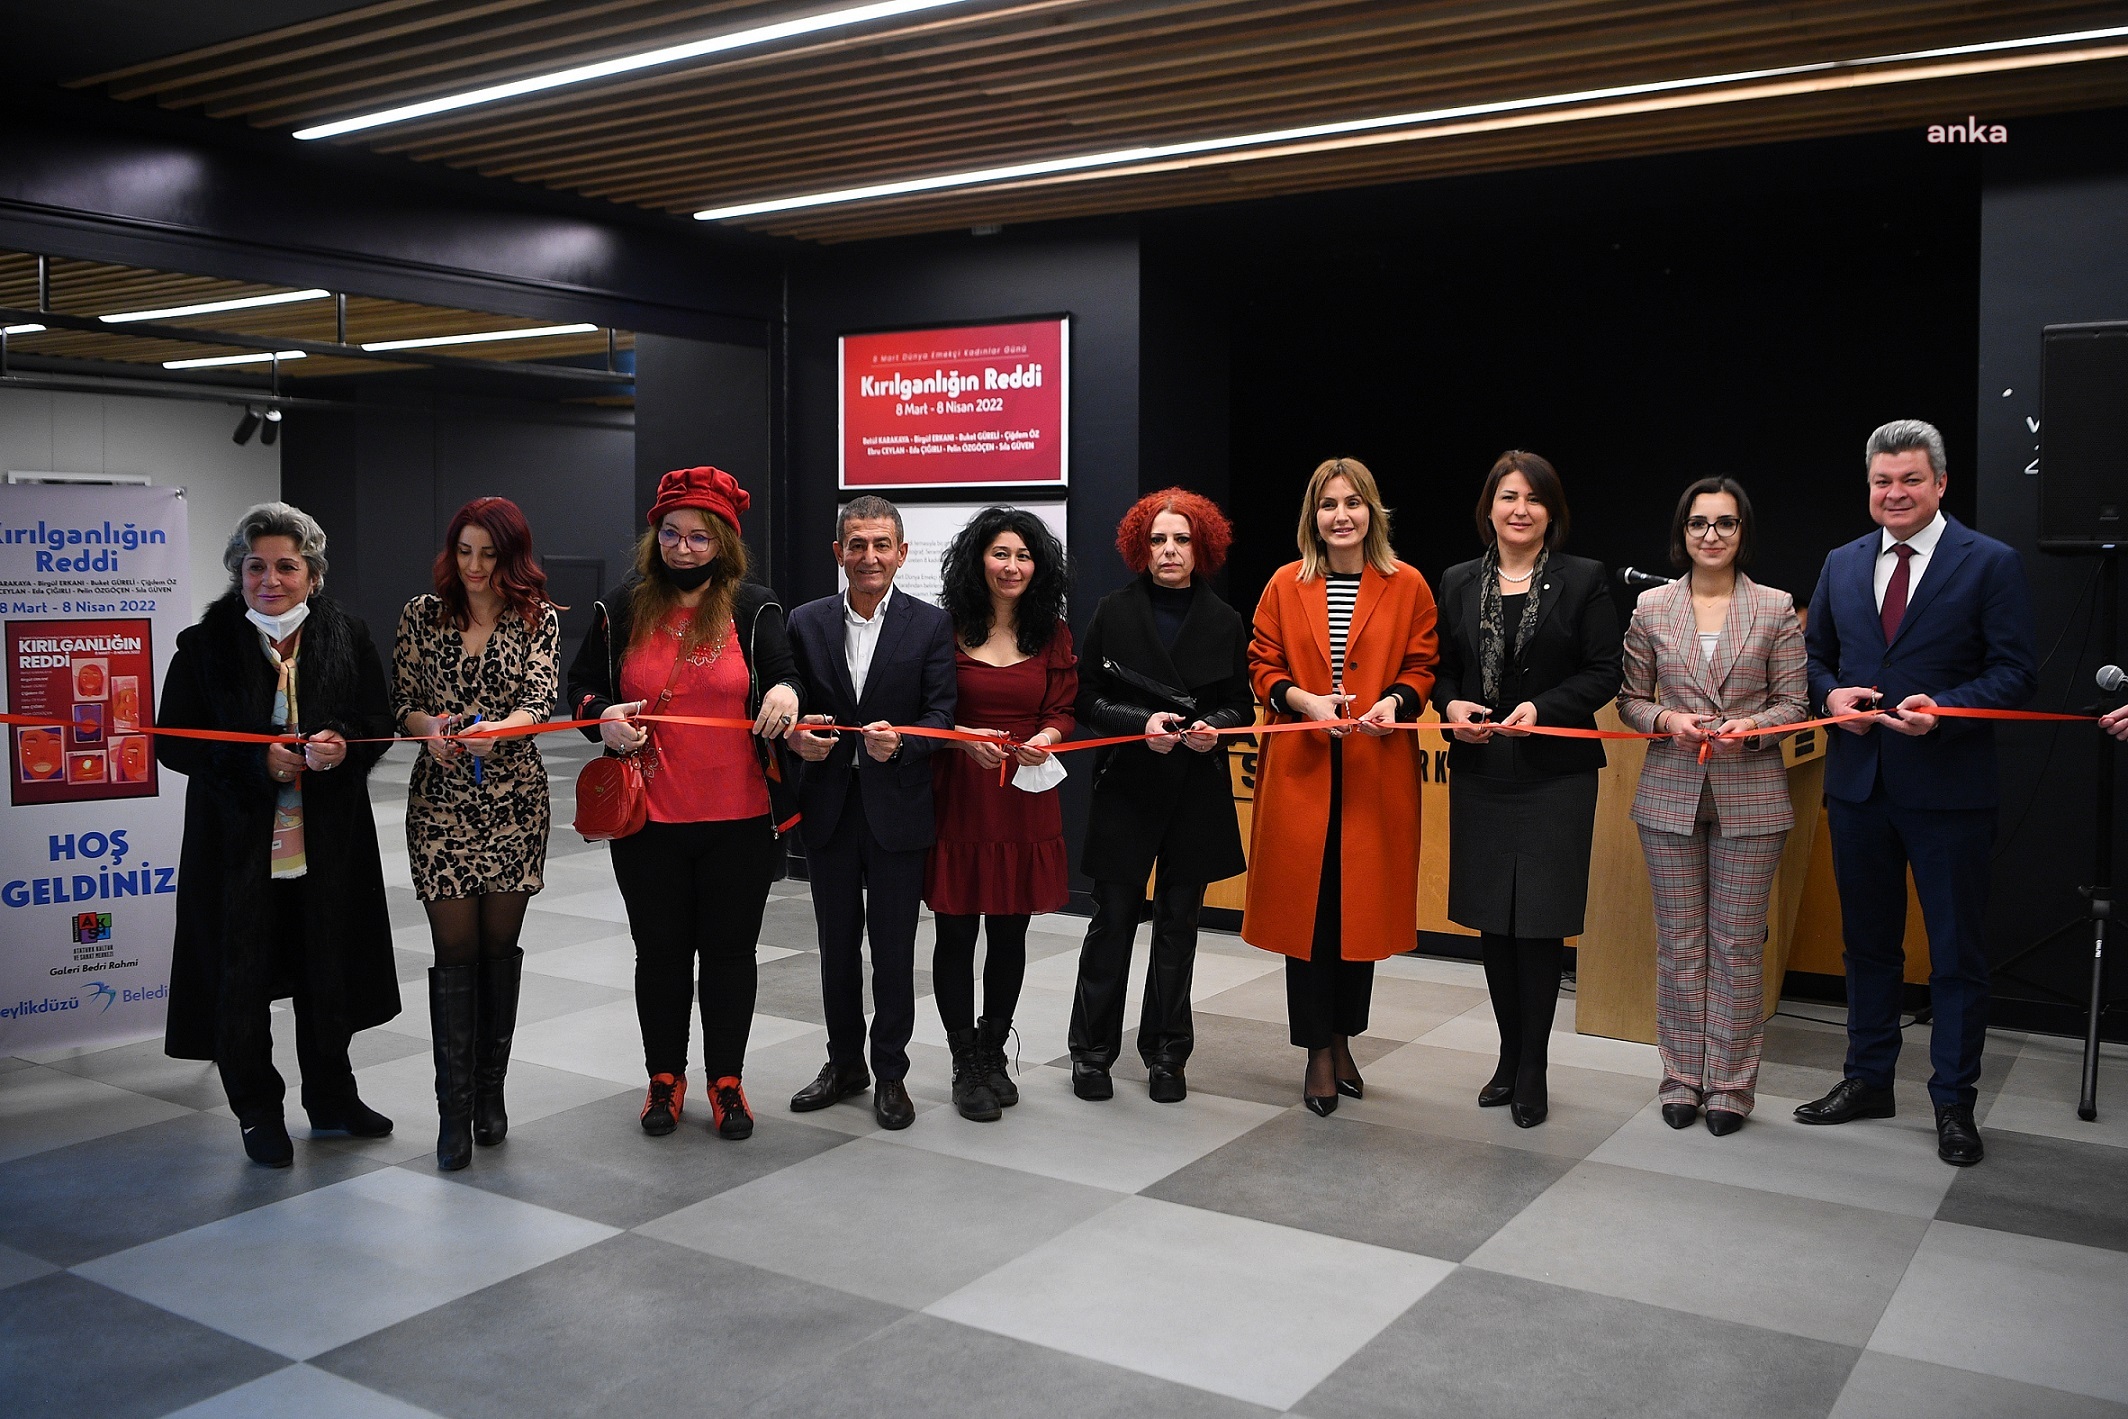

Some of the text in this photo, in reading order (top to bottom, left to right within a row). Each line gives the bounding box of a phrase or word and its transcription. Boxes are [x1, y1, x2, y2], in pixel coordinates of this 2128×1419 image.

[880, 354, 899, 362] Mart
[902, 352, 928, 362] Dünya
[931, 349, 960, 360] Emekçi
[964, 347, 1000, 357] Kadınlar
[1004, 344, 1027, 355] Günü
[861, 363, 1042, 400] Kırılganlığın Reddi
[896, 403, 903, 416] 8
[904, 402, 928, 416] Mart
[936, 401, 944, 414] 8
[946, 400, 974, 414] Nisan
[976, 398, 1003, 412] 2022
[1004, 430, 1028, 442] Çiğdem
[1029, 428, 1040, 438] ÖZ
[1011, 440, 1034, 450] GÜVEN
[0, 520, 166, 550] ırılganlığın
[36, 549, 118, 572] Reddi
[38, 580, 58, 588] Birgül
[94, 586, 130, 594] ÖZGÖÇEN
[0, 602, 8, 614] 8
[13, 601, 48, 614] Mart
[62, 601, 71, 613] 8
[76, 600, 115, 612] Nisan
[120, 600, 156, 612] 2022
[19, 634, 140, 652] KIRILGANLIĞIN
[20, 652, 70, 668] REDDİ
[49, 829, 128, 866] HOŞ
[2, 862, 176, 908] GELDİNİZ
[50, 959, 138, 976] Galeri Bedri Rahmi
